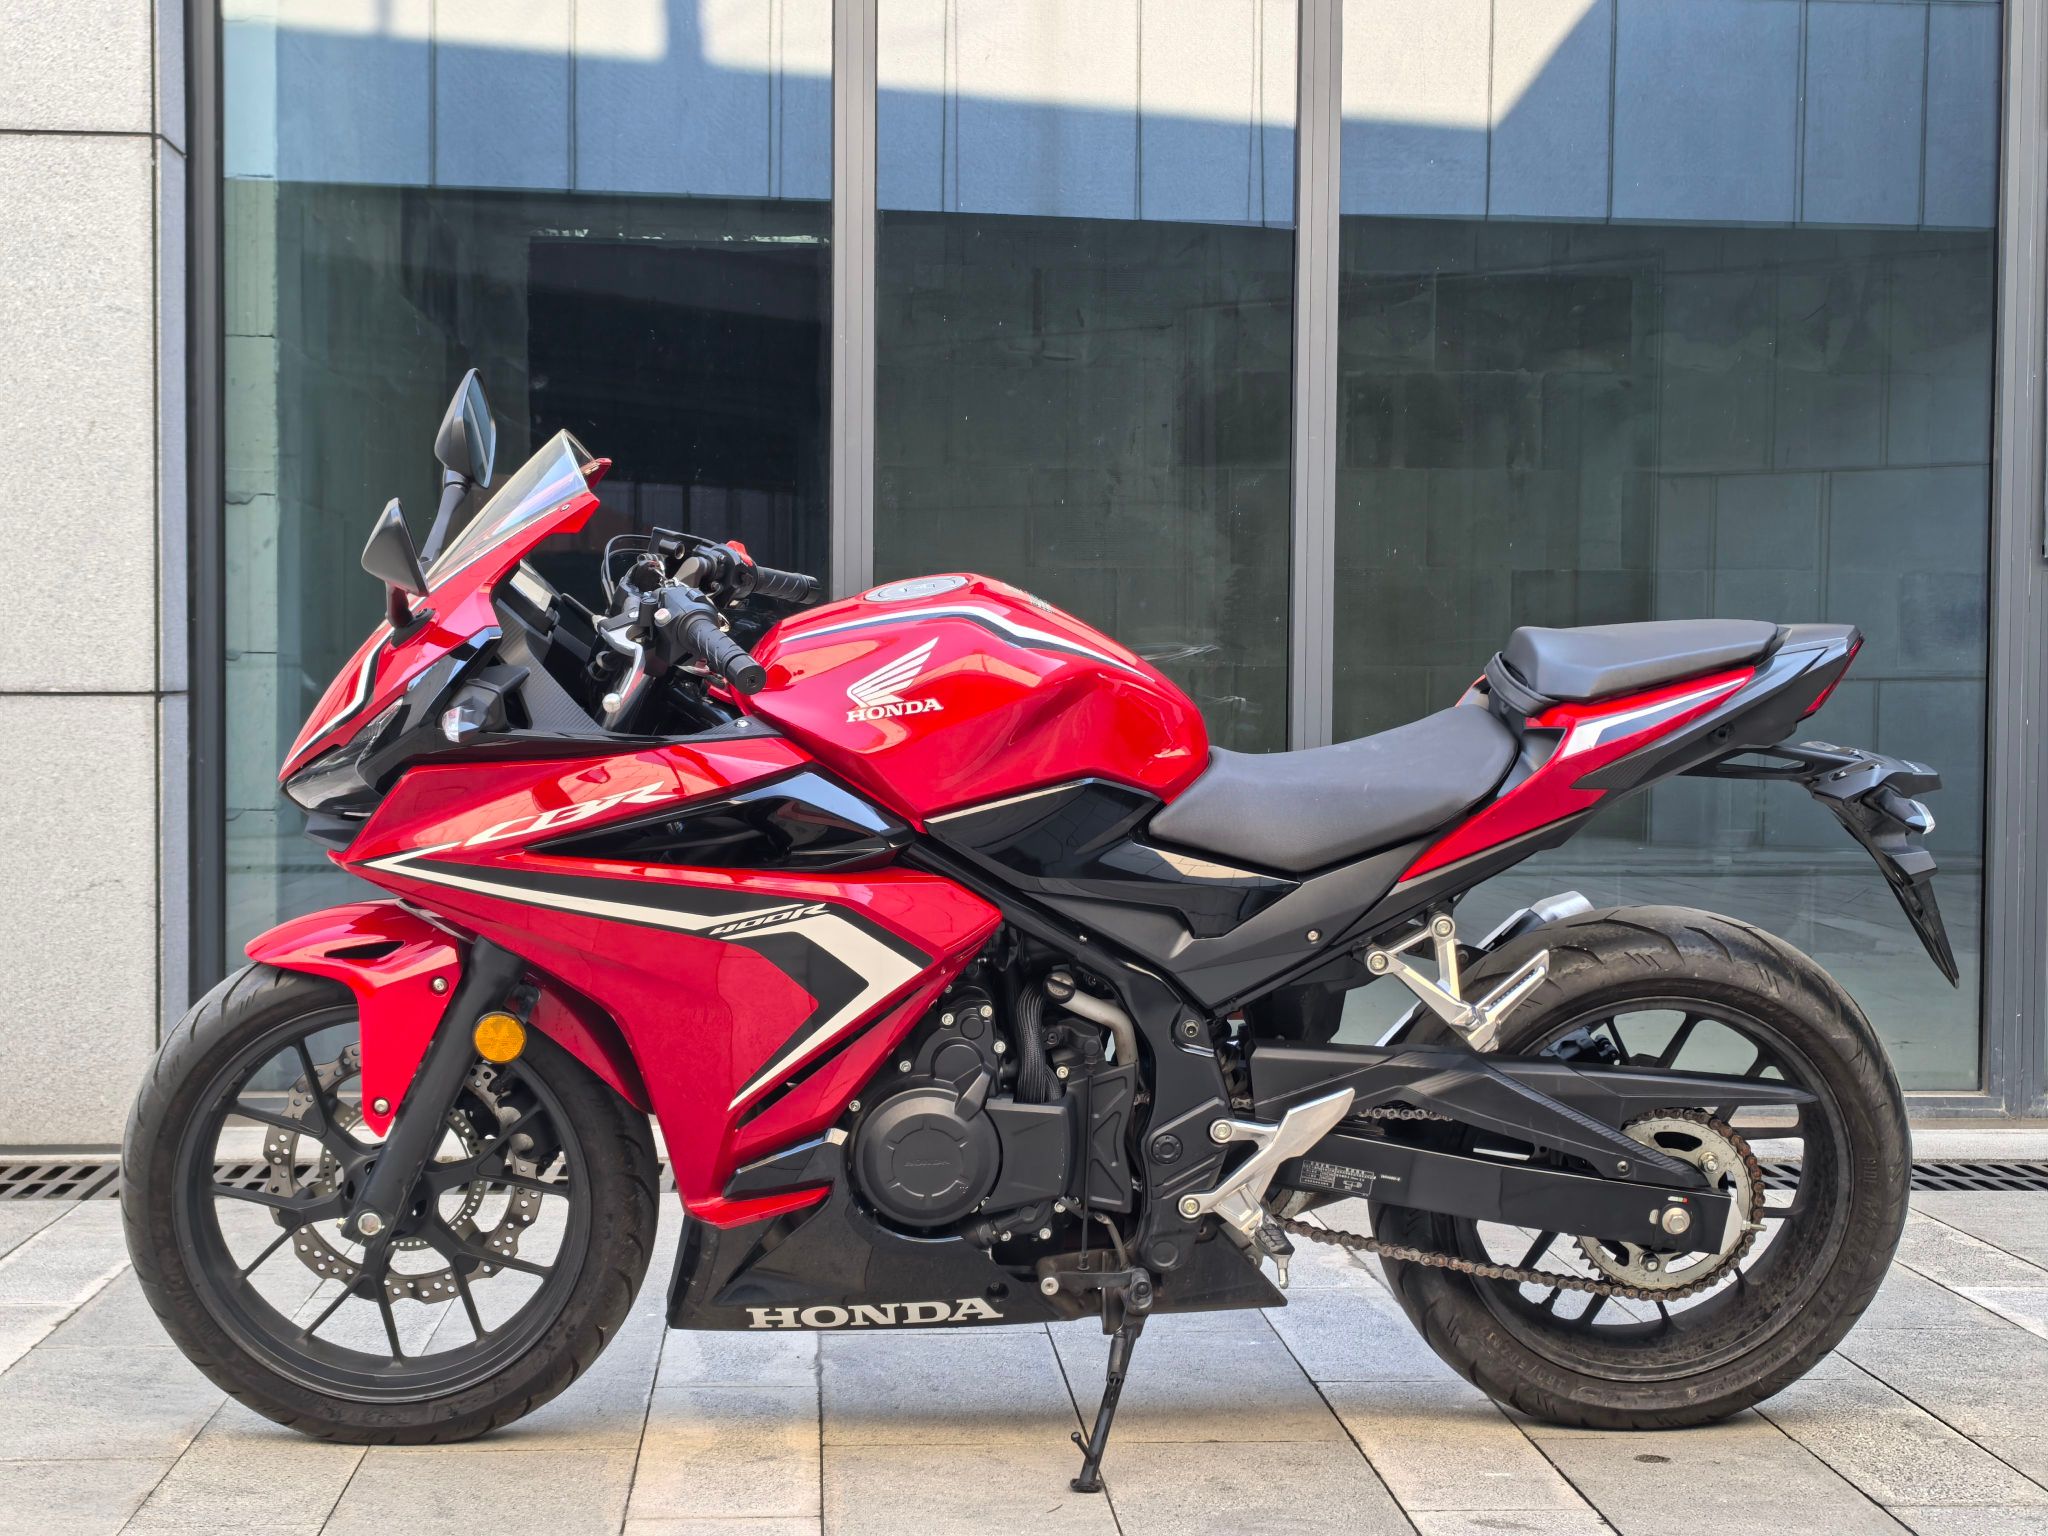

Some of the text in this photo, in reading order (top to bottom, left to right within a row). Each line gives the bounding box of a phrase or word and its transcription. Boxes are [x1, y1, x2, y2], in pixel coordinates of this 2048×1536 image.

[846, 698, 944, 723] HONDA
[464, 781, 681, 847] CBR
[709, 902, 830, 935] 400R
[746, 1297, 1003, 1328] HONDA
